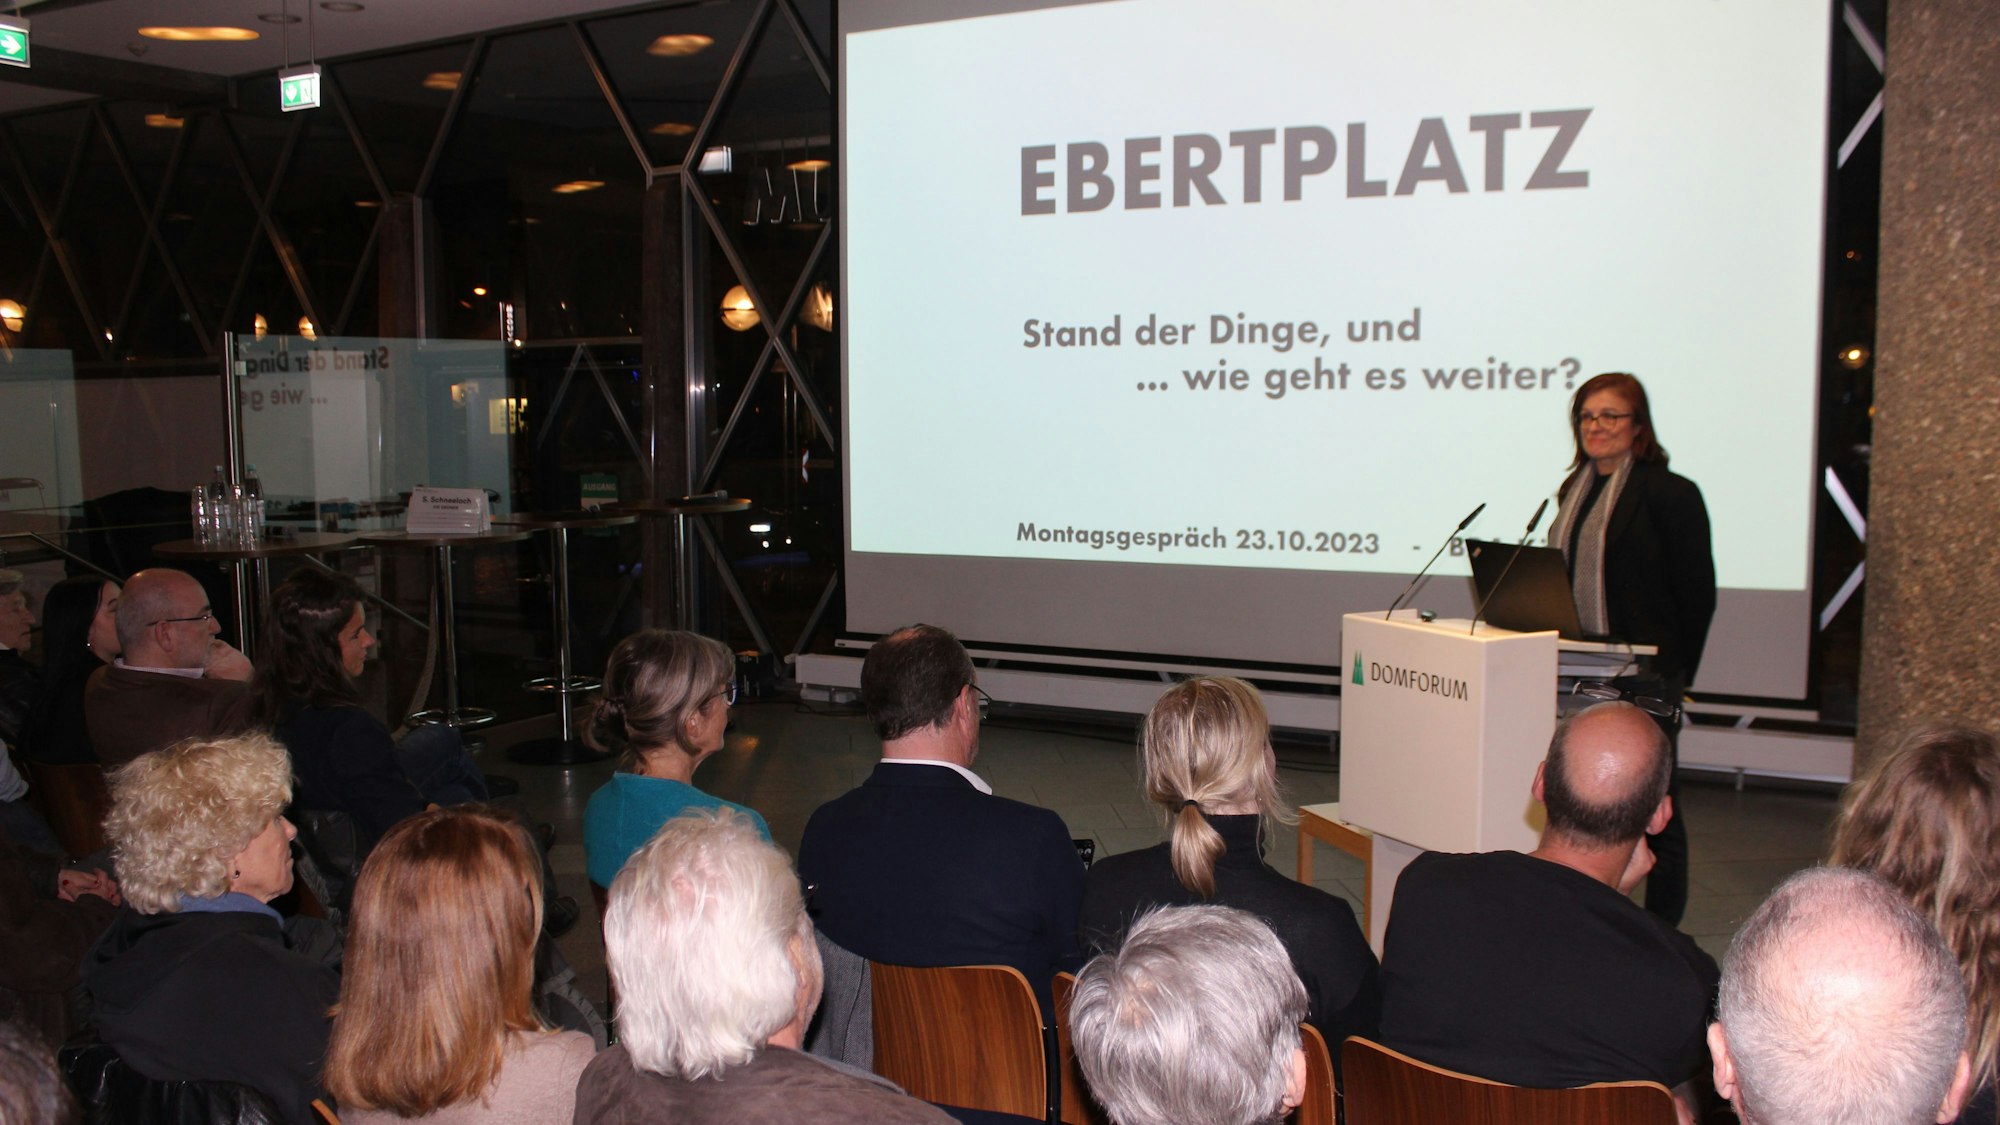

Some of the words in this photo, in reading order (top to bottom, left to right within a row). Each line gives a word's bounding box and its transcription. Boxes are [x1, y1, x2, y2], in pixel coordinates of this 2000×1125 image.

[1021, 108, 1593, 217] EBERTPLATZ
[1023, 313, 1122, 349] Stand
[1134, 313, 1196, 347] der
[1210, 311, 1331, 353] Dinge,
[1347, 307, 1421, 343] und
[1181, 358, 1250, 391] wie
[1264, 356, 1352, 400] geht
[1364, 367, 1407, 391] es
[1421, 356, 1580, 391] weiter?
[582, 482, 617, 491] AUSGANG
[1016, 522, 1227, 553] Montagsgespräch
[1236, 528, 1380, 555] 23.10.2023
[1371, 662, 1468, 701] DOMFORUM
